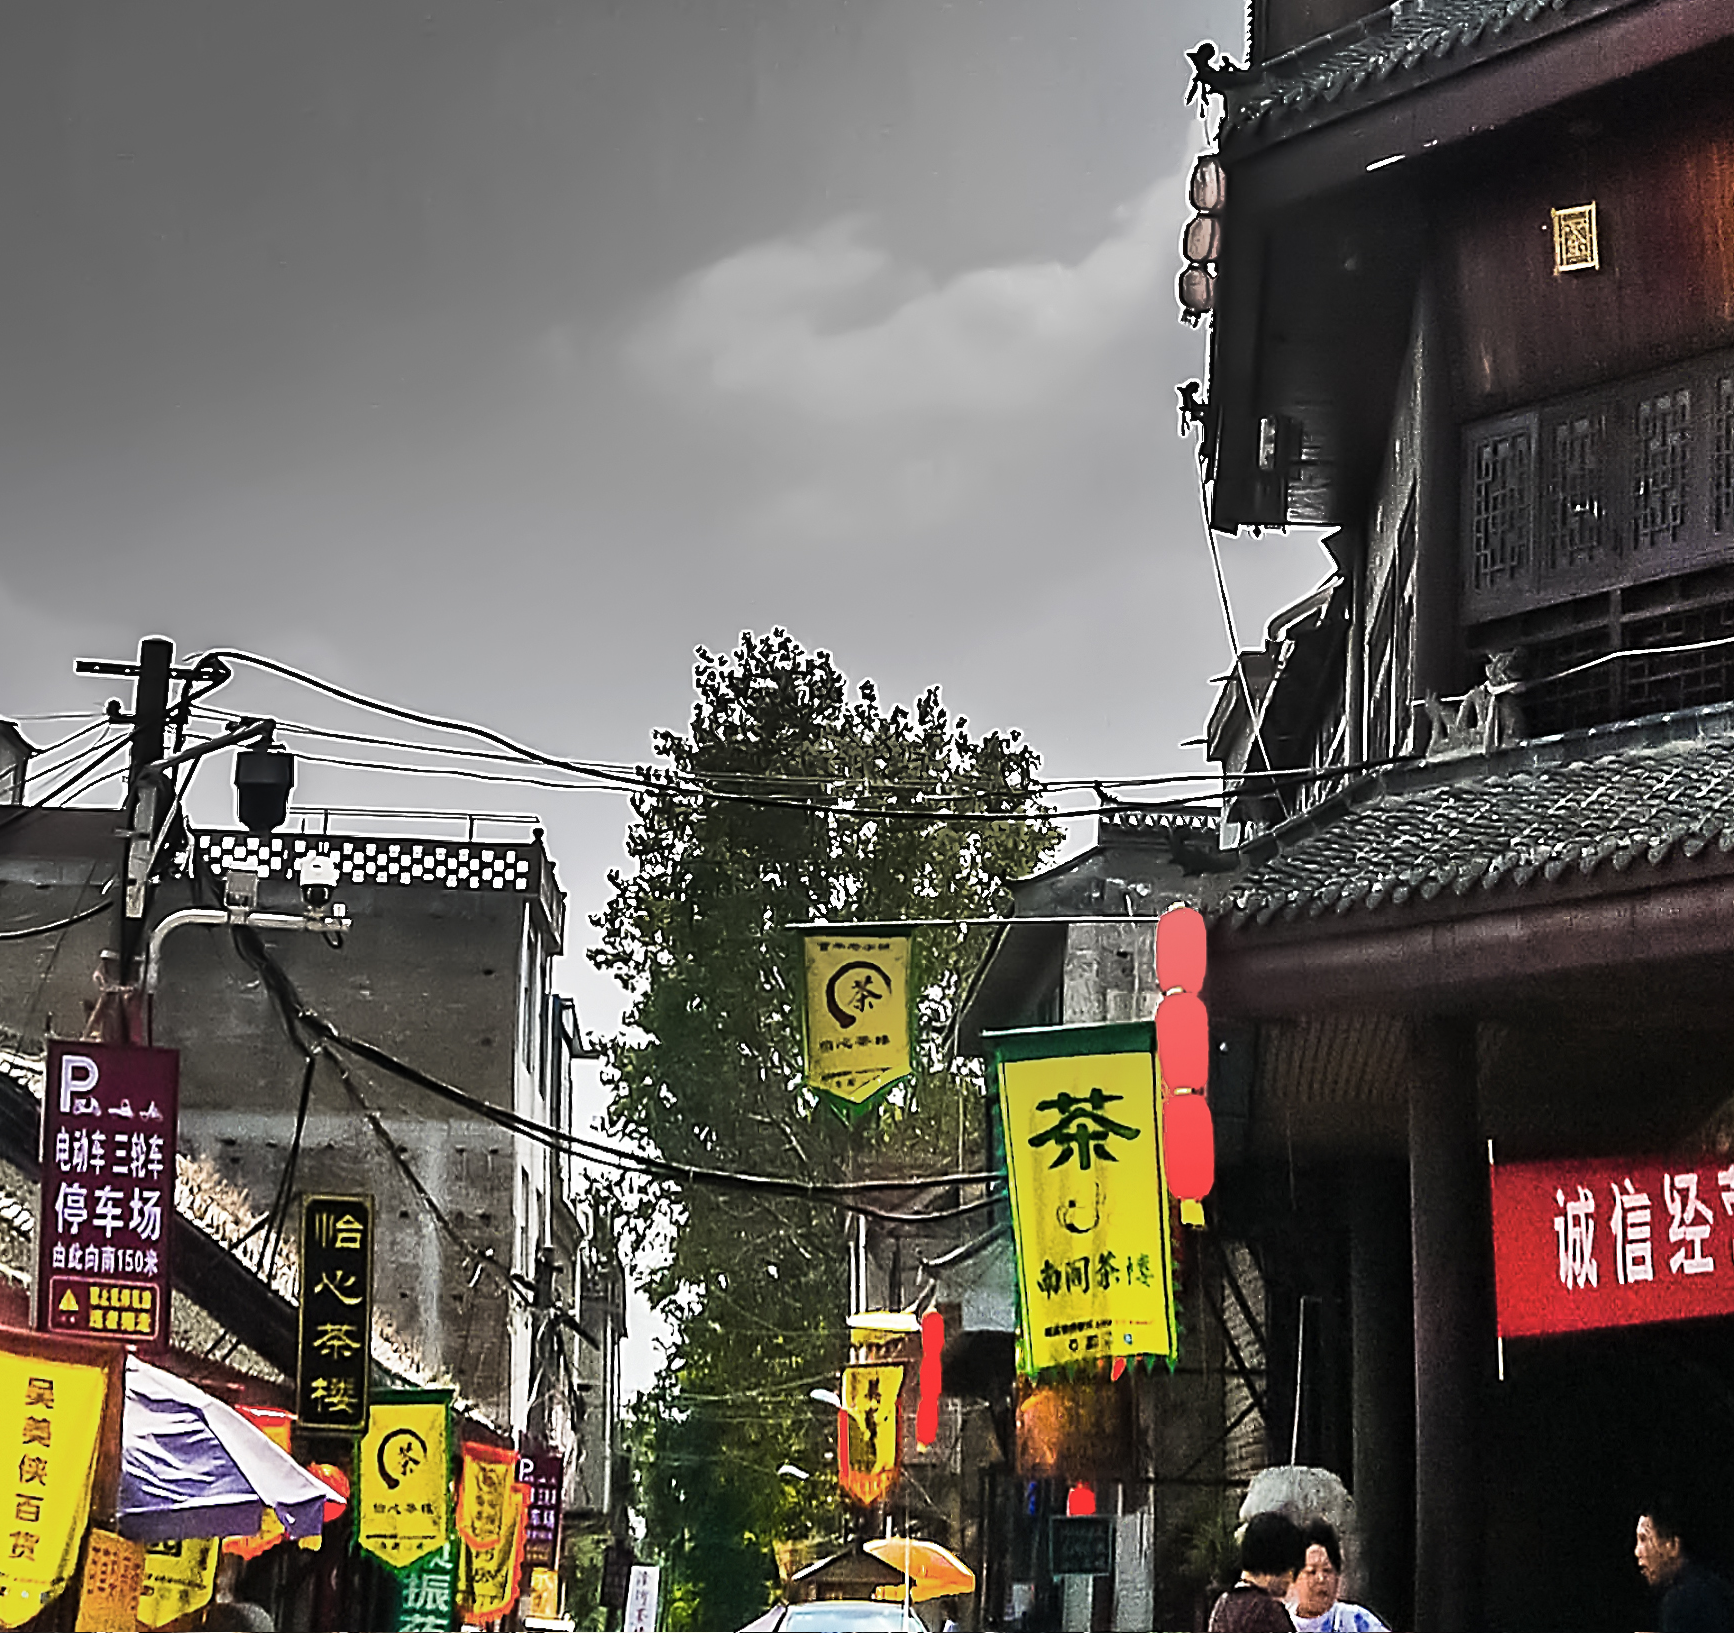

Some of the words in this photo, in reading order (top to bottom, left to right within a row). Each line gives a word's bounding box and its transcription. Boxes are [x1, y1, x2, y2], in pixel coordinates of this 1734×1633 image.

[59, 1053, 100, 1113] P
[55, 1125, 107, 1175] 电动车
[112, 1131, 164, 1180] 三轮车
[1028, 1087, 1141, 1171] 茶
[54, 1181, 162, 1241] 停车场
[519, 1457, 535, 1482] P
